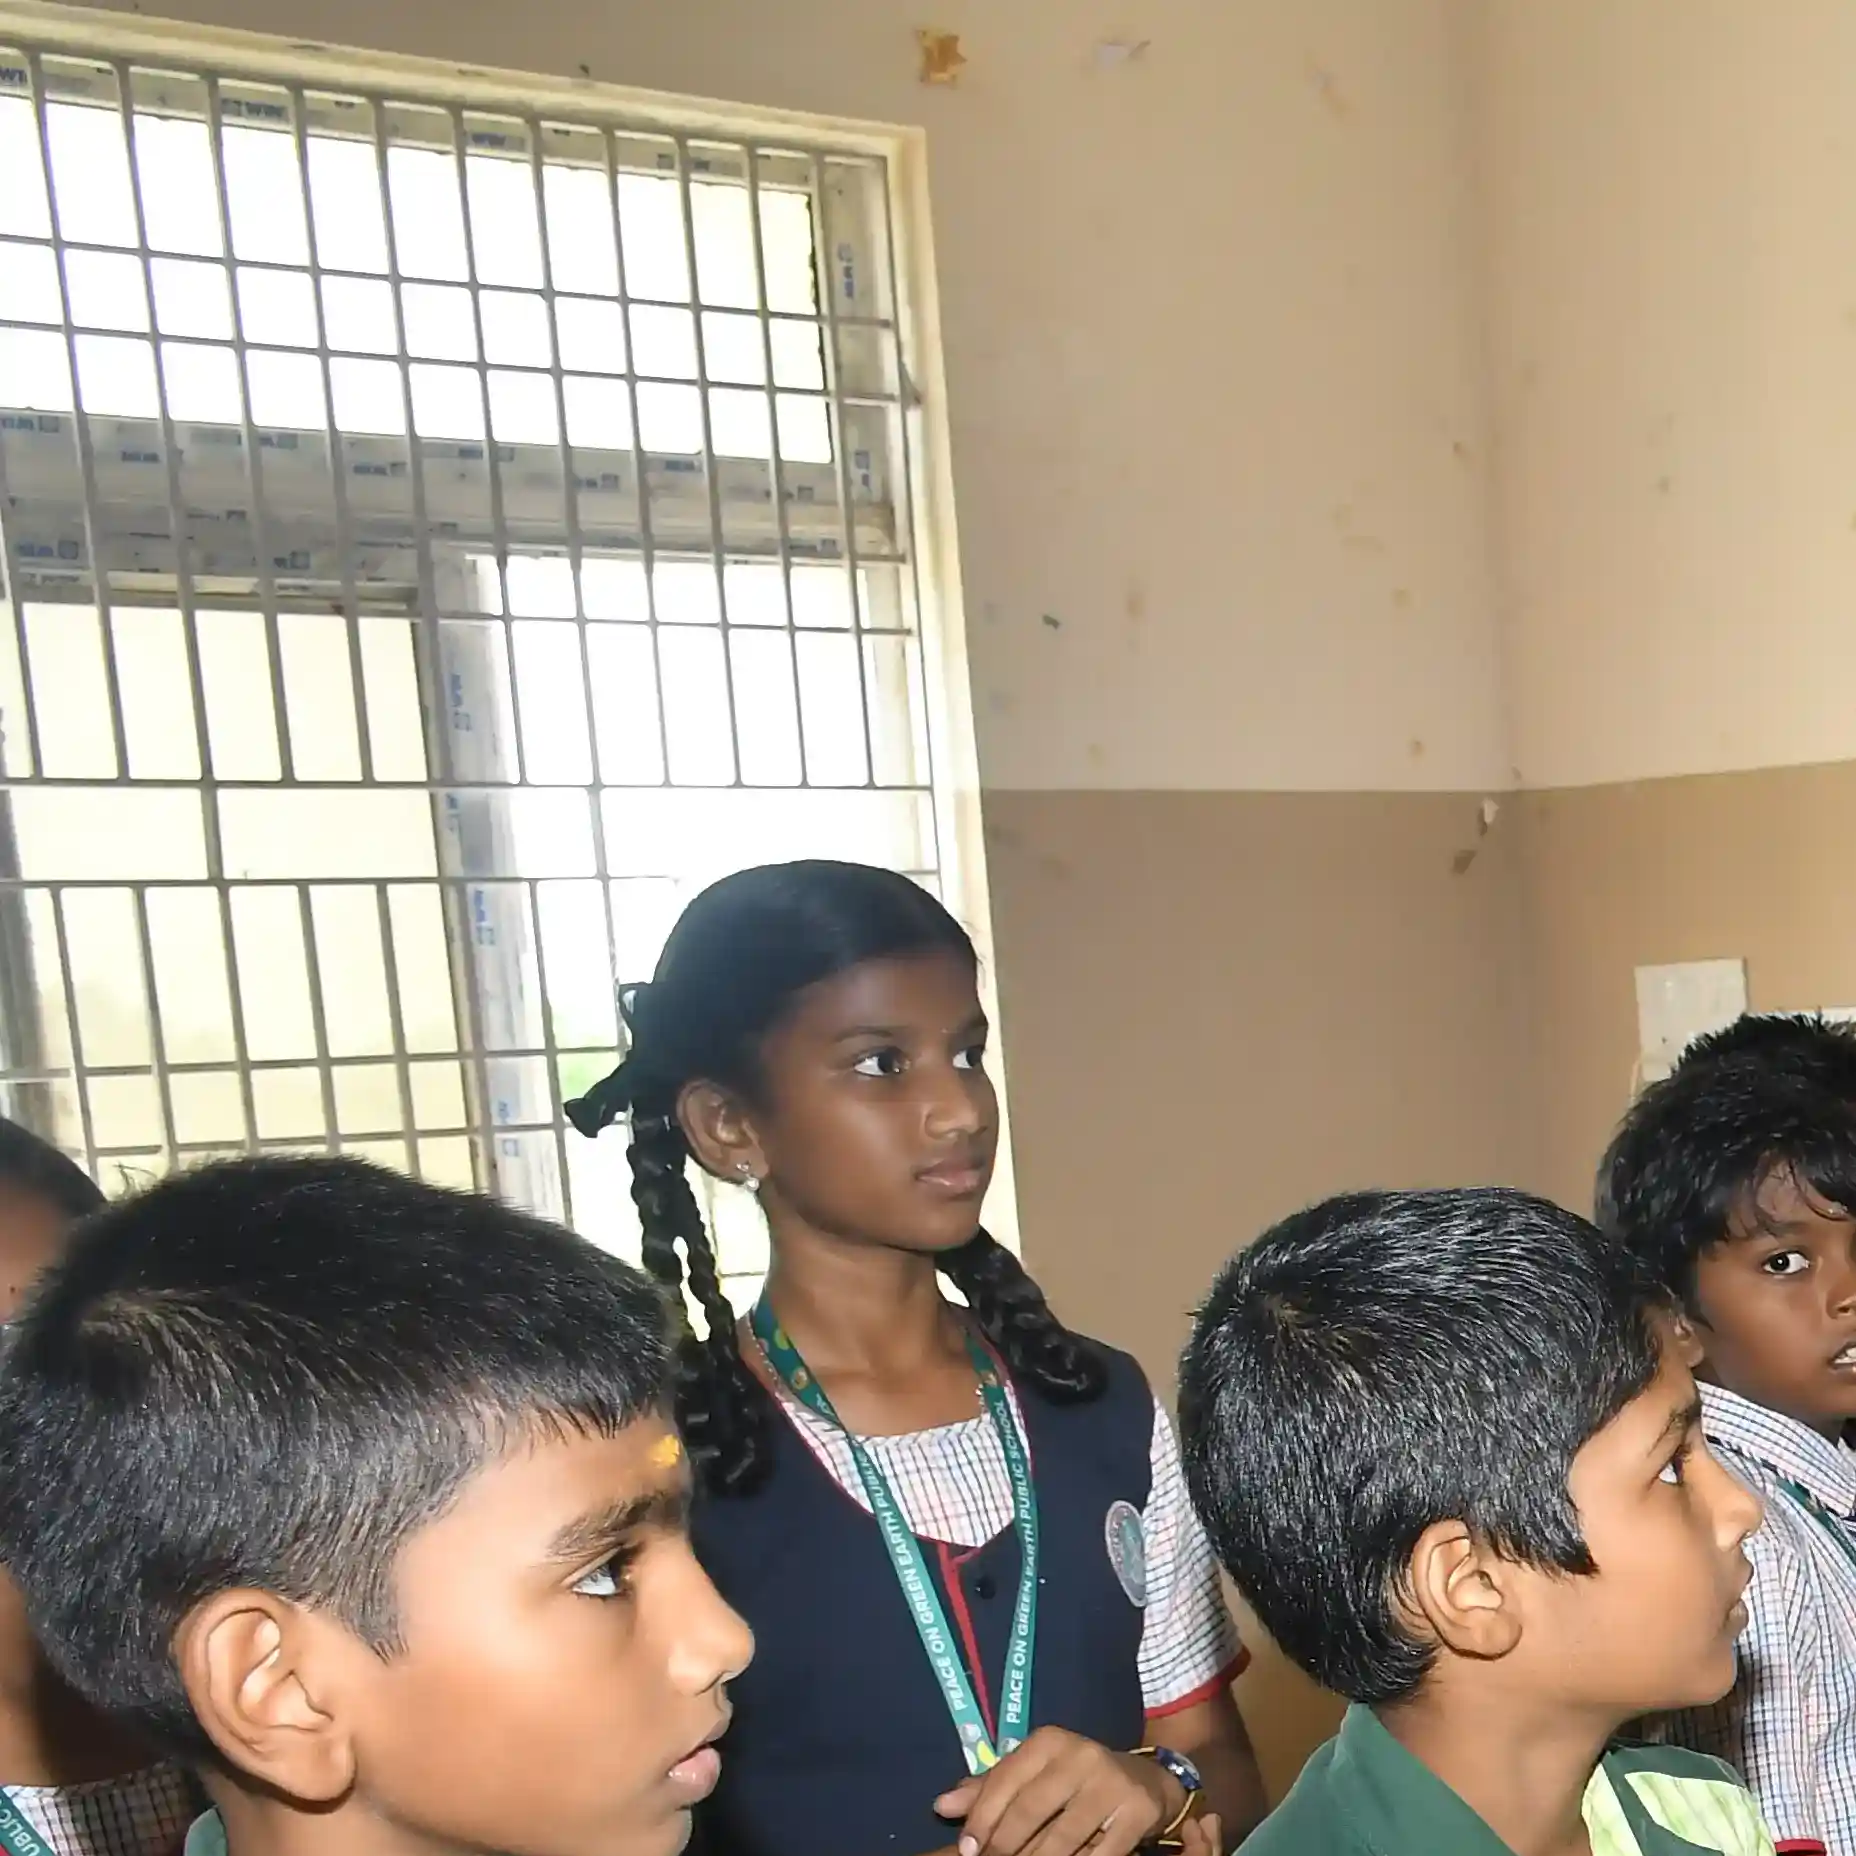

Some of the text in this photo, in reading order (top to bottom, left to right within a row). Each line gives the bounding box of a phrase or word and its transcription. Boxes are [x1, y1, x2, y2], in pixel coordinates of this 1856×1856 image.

[882, 1511, 913, 1567] EARTH
[996, 1401, 1037, 1724] PEACE ON GREEN EARTH PUBLIC SCHOOL
[903, 1567, 935, 1625] GREEN
[924, 1625, 945, 1653] ON
[937, 1656, 968, 1711] PEACE
